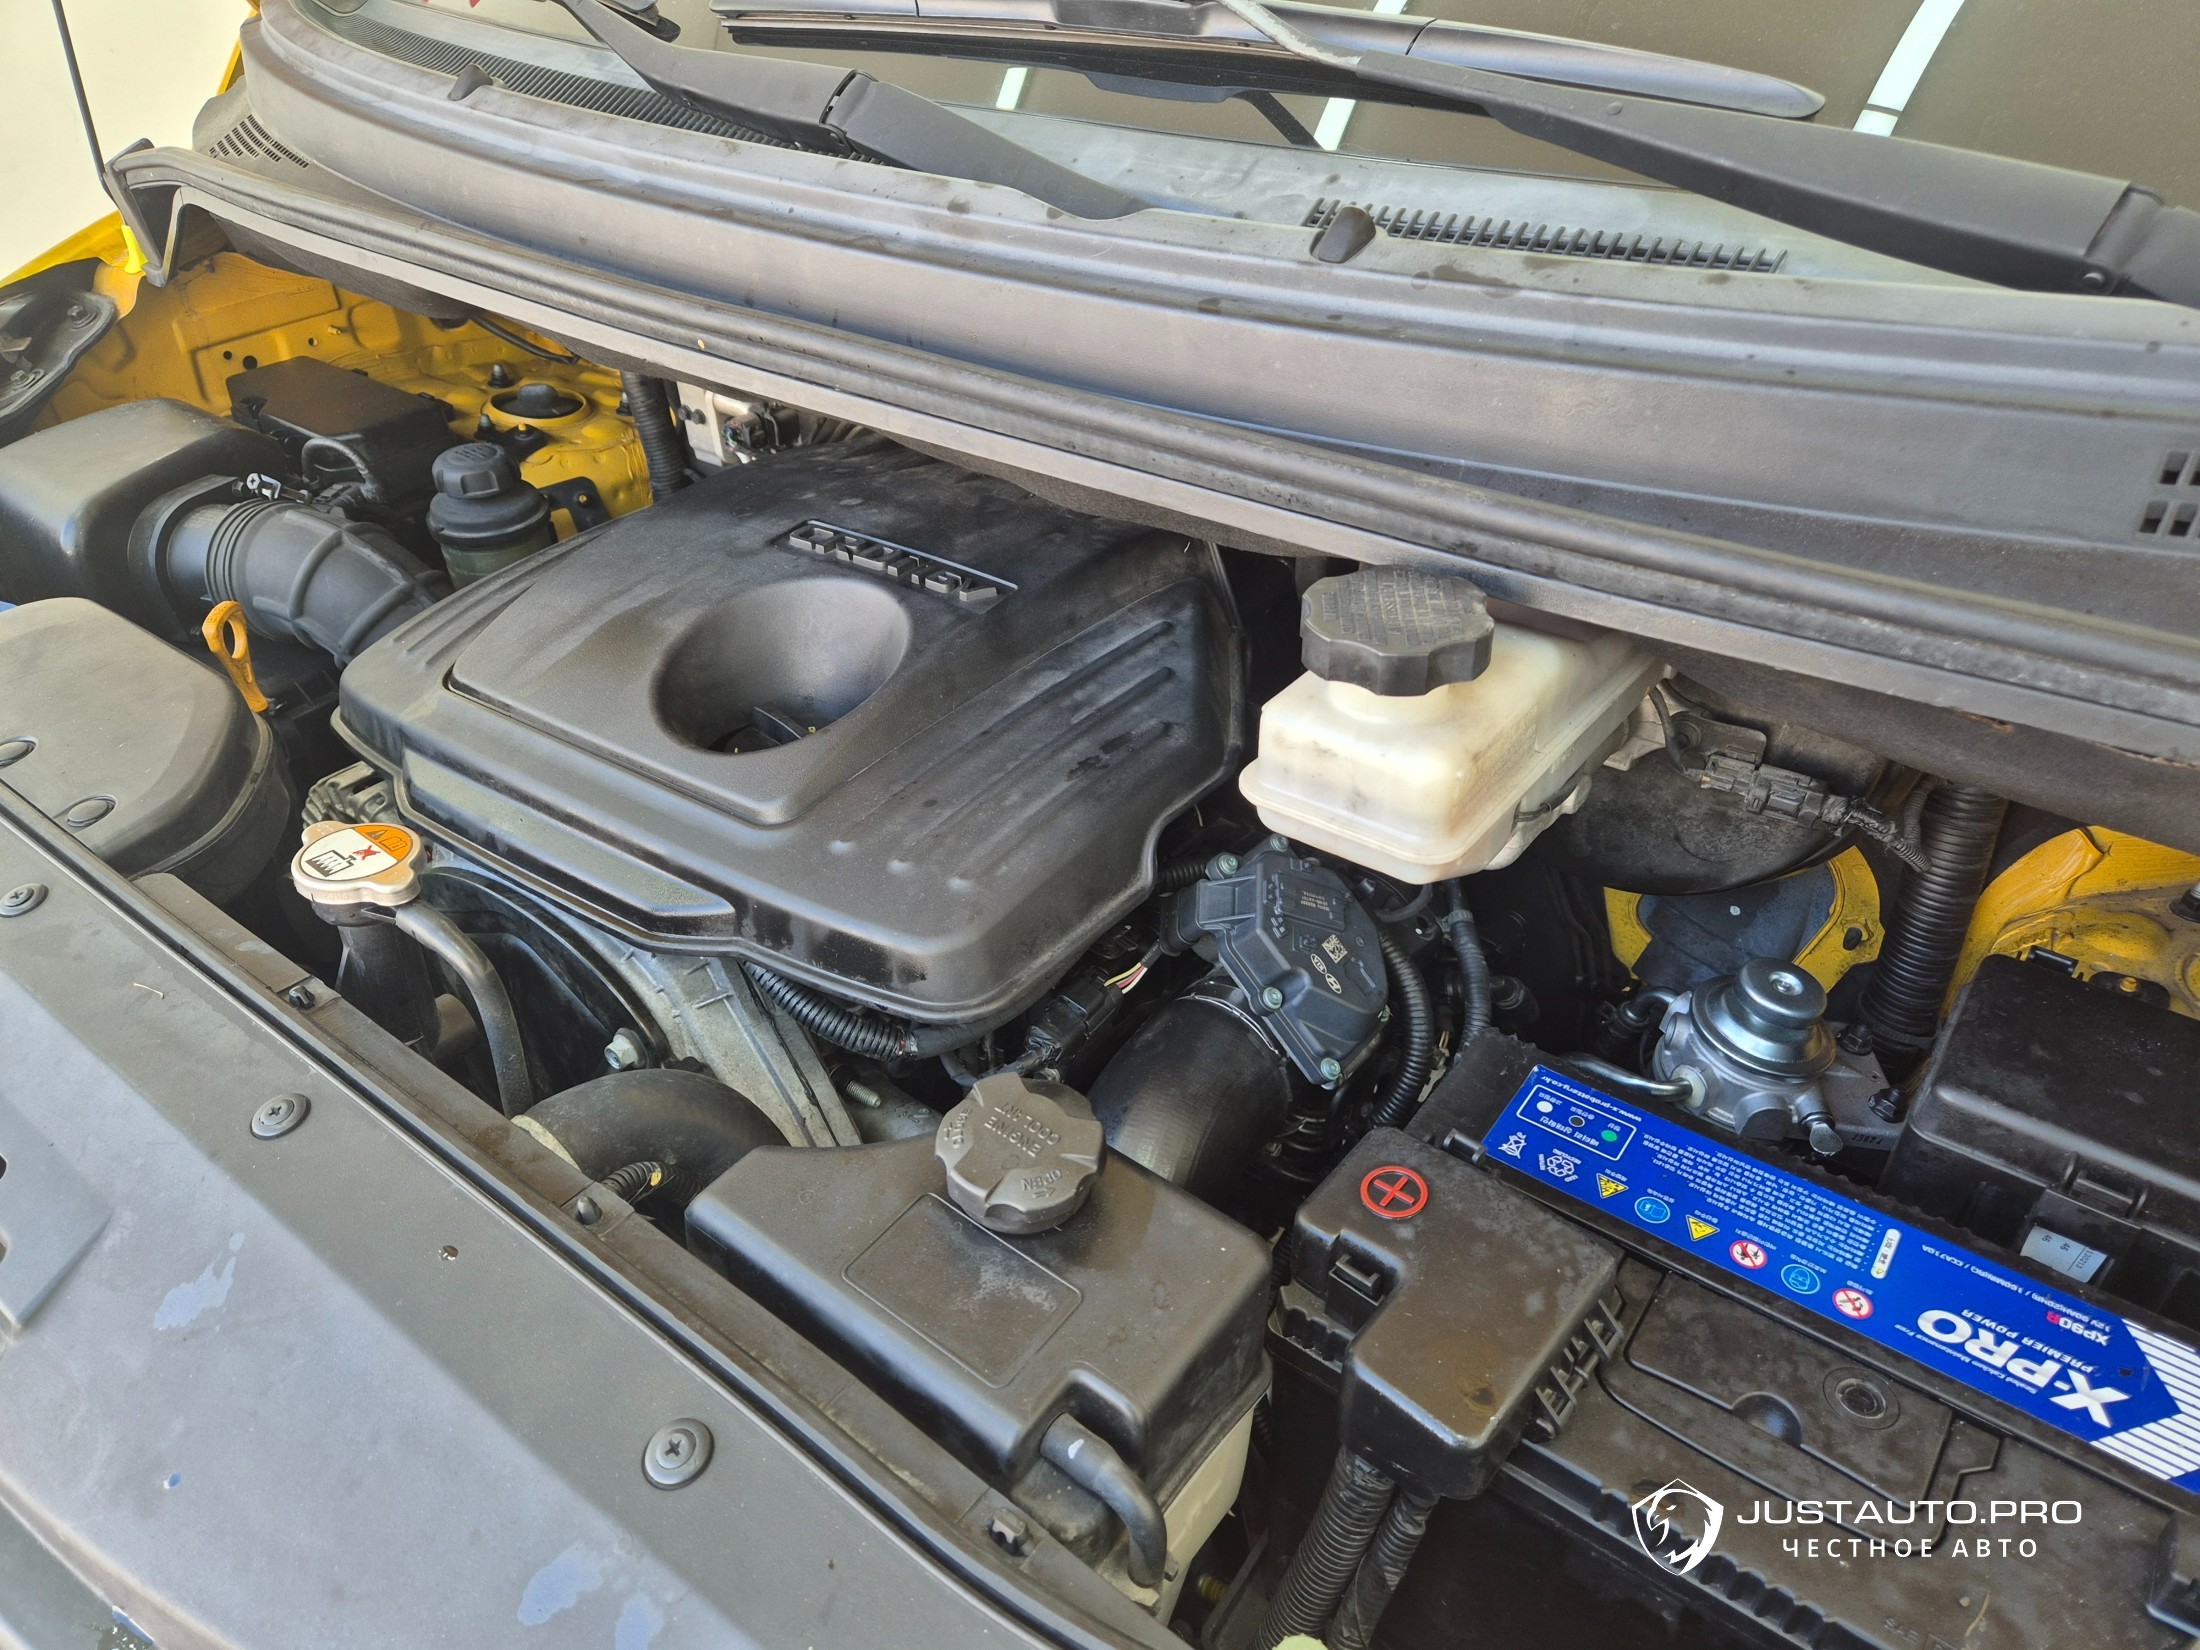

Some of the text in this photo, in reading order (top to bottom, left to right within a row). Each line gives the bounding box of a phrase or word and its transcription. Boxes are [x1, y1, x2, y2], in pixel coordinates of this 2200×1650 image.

[1540, 1074, 1642, 1123] www.x-probattery.co.kr
[984, 1116, 1041, 1158] ENGINE
[994, 1101, 1061, 1146] COOLANT
[1539, 1114, 1599, 1147] 배터리 상태확인
[1552, 1147, 1581, 1165] RECYCLING
[1020, 1169, 1062, 1192] OPEN
[1960, 1307, 2094, 1374] PREMIER POWER
[2044, 1309, 2110, 1347] XP90R
[1916, 1310, 2132, 1429] X-PRO
